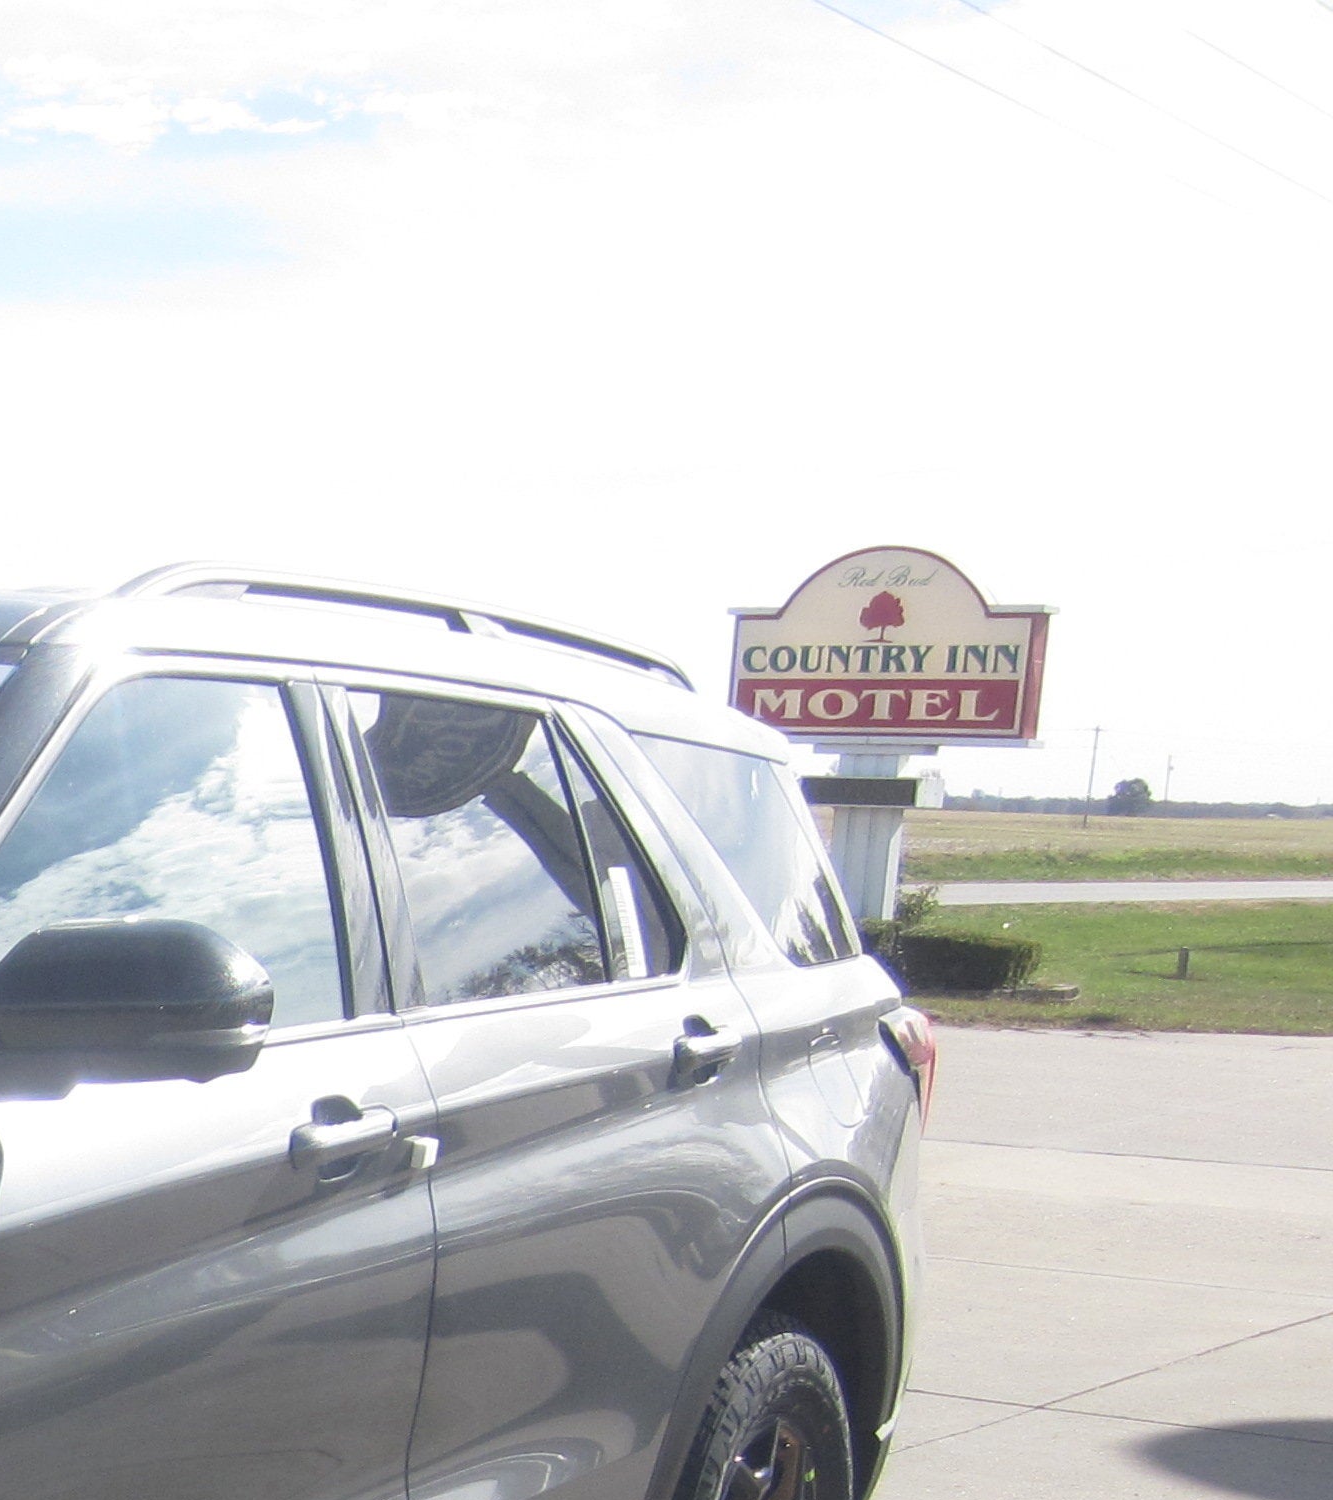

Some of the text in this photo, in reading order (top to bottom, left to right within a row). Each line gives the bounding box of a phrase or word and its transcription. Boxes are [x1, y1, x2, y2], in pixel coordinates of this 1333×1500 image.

[838, 565, 935, 588] Red Bud
[742, 644, 1022, 673] COUNTRY INN
[752, 688, 1001, 722] MOTEL
